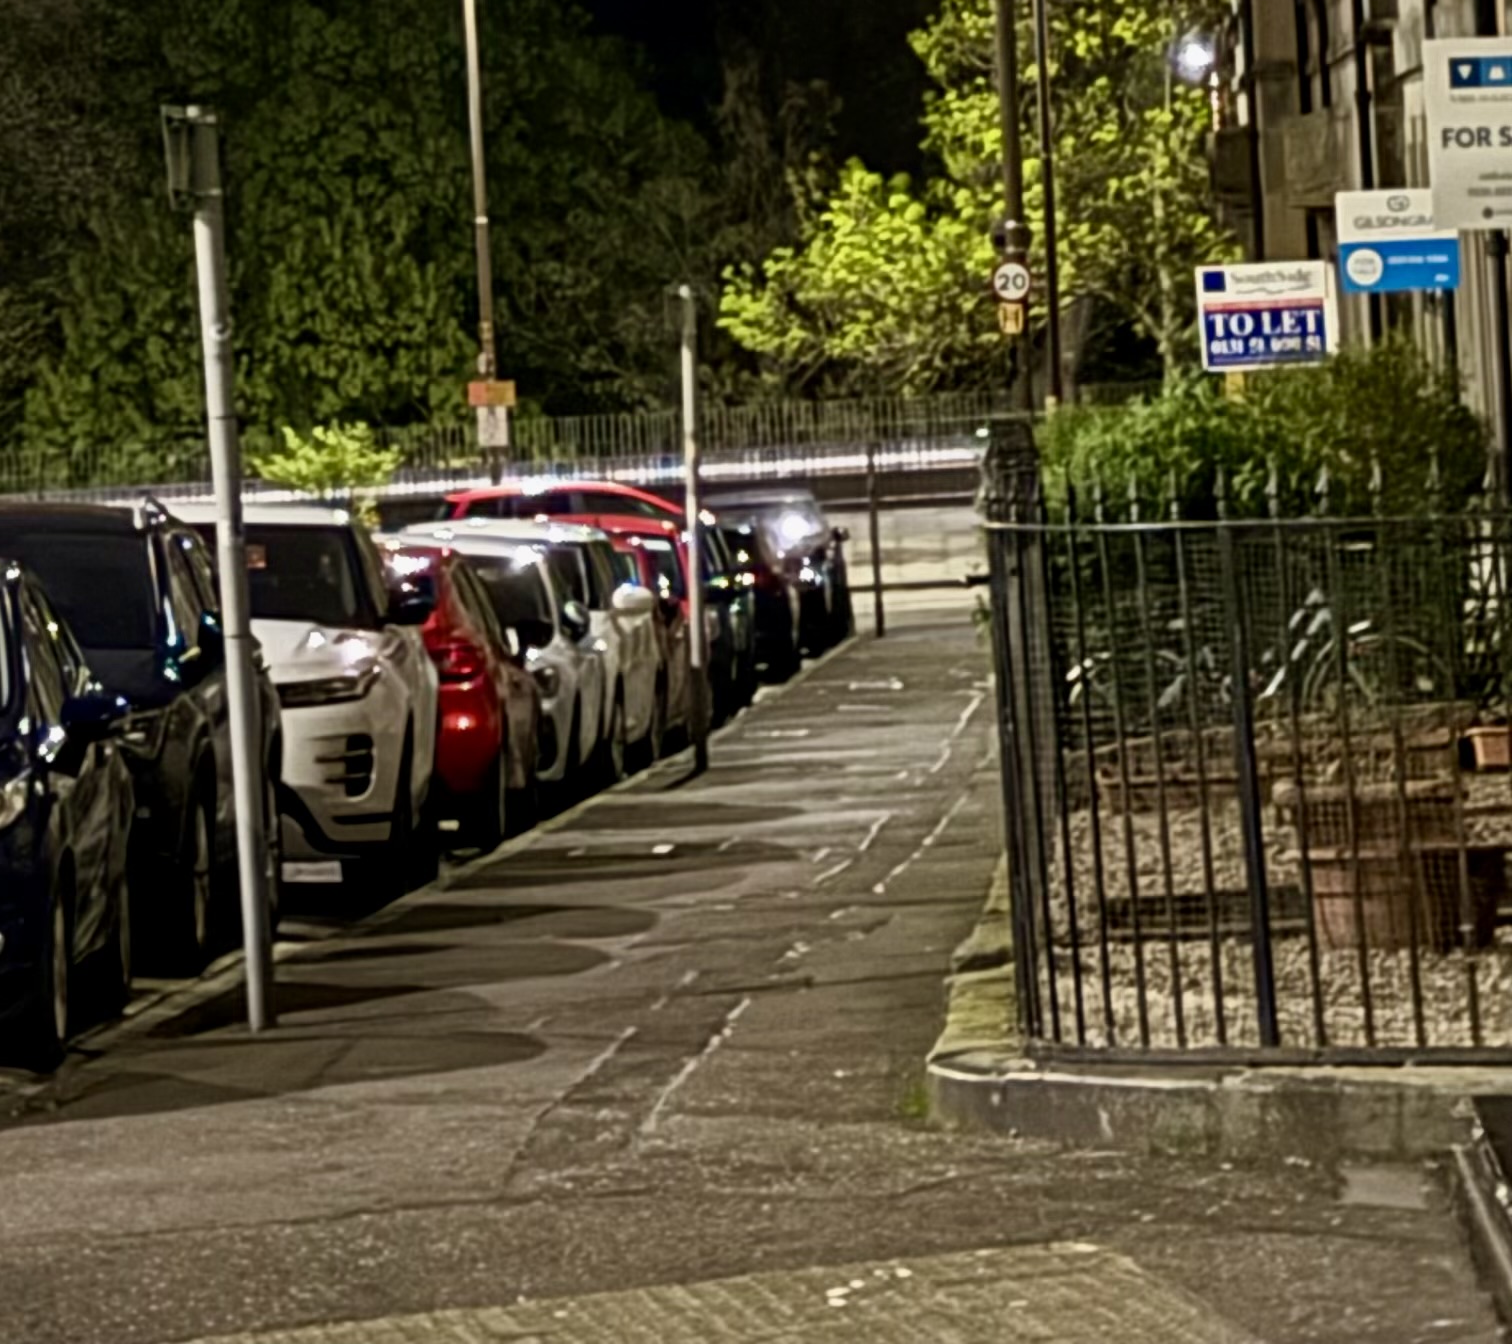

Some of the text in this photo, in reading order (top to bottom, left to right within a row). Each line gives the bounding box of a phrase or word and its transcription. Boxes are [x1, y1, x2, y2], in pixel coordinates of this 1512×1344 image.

[1441, 126, 1492, 149] FOR
[997, 272, 1026, 292] 20
[1208, 309, 1321, 338] TO LET
